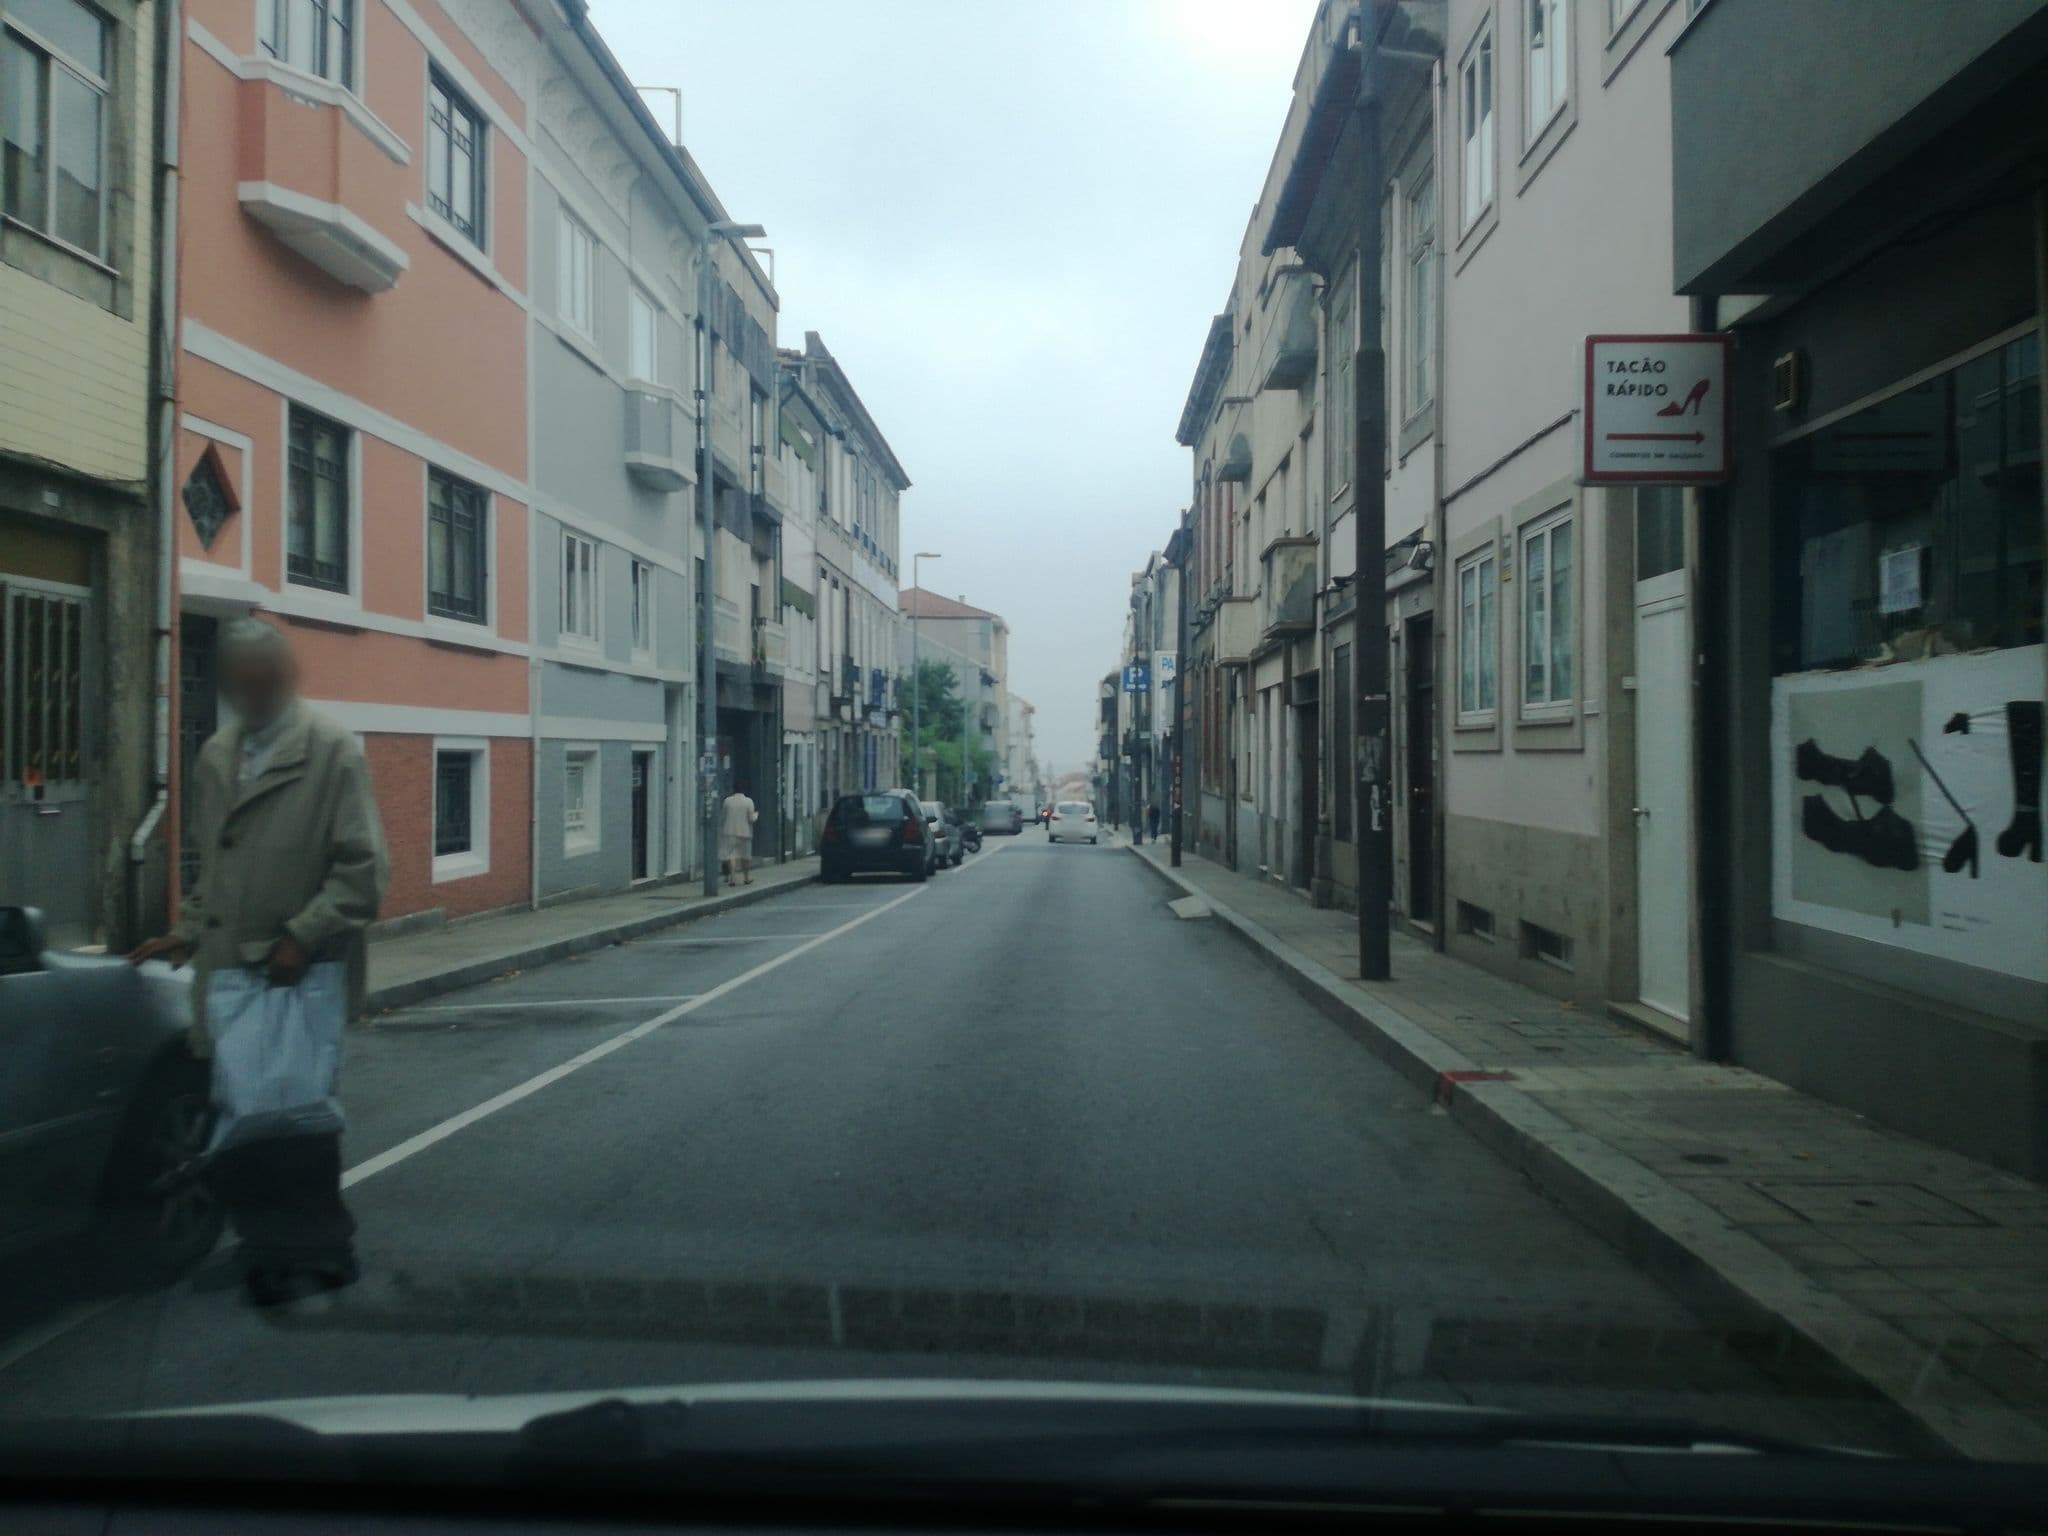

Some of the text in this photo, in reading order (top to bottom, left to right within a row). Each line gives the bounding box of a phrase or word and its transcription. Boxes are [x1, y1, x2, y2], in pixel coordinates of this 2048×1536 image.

[1607, 357, 1666, 373] TACÃO
[1607, 379, 1668, 396] RÁPIDO
[1129, 667, 1144, 684] P
